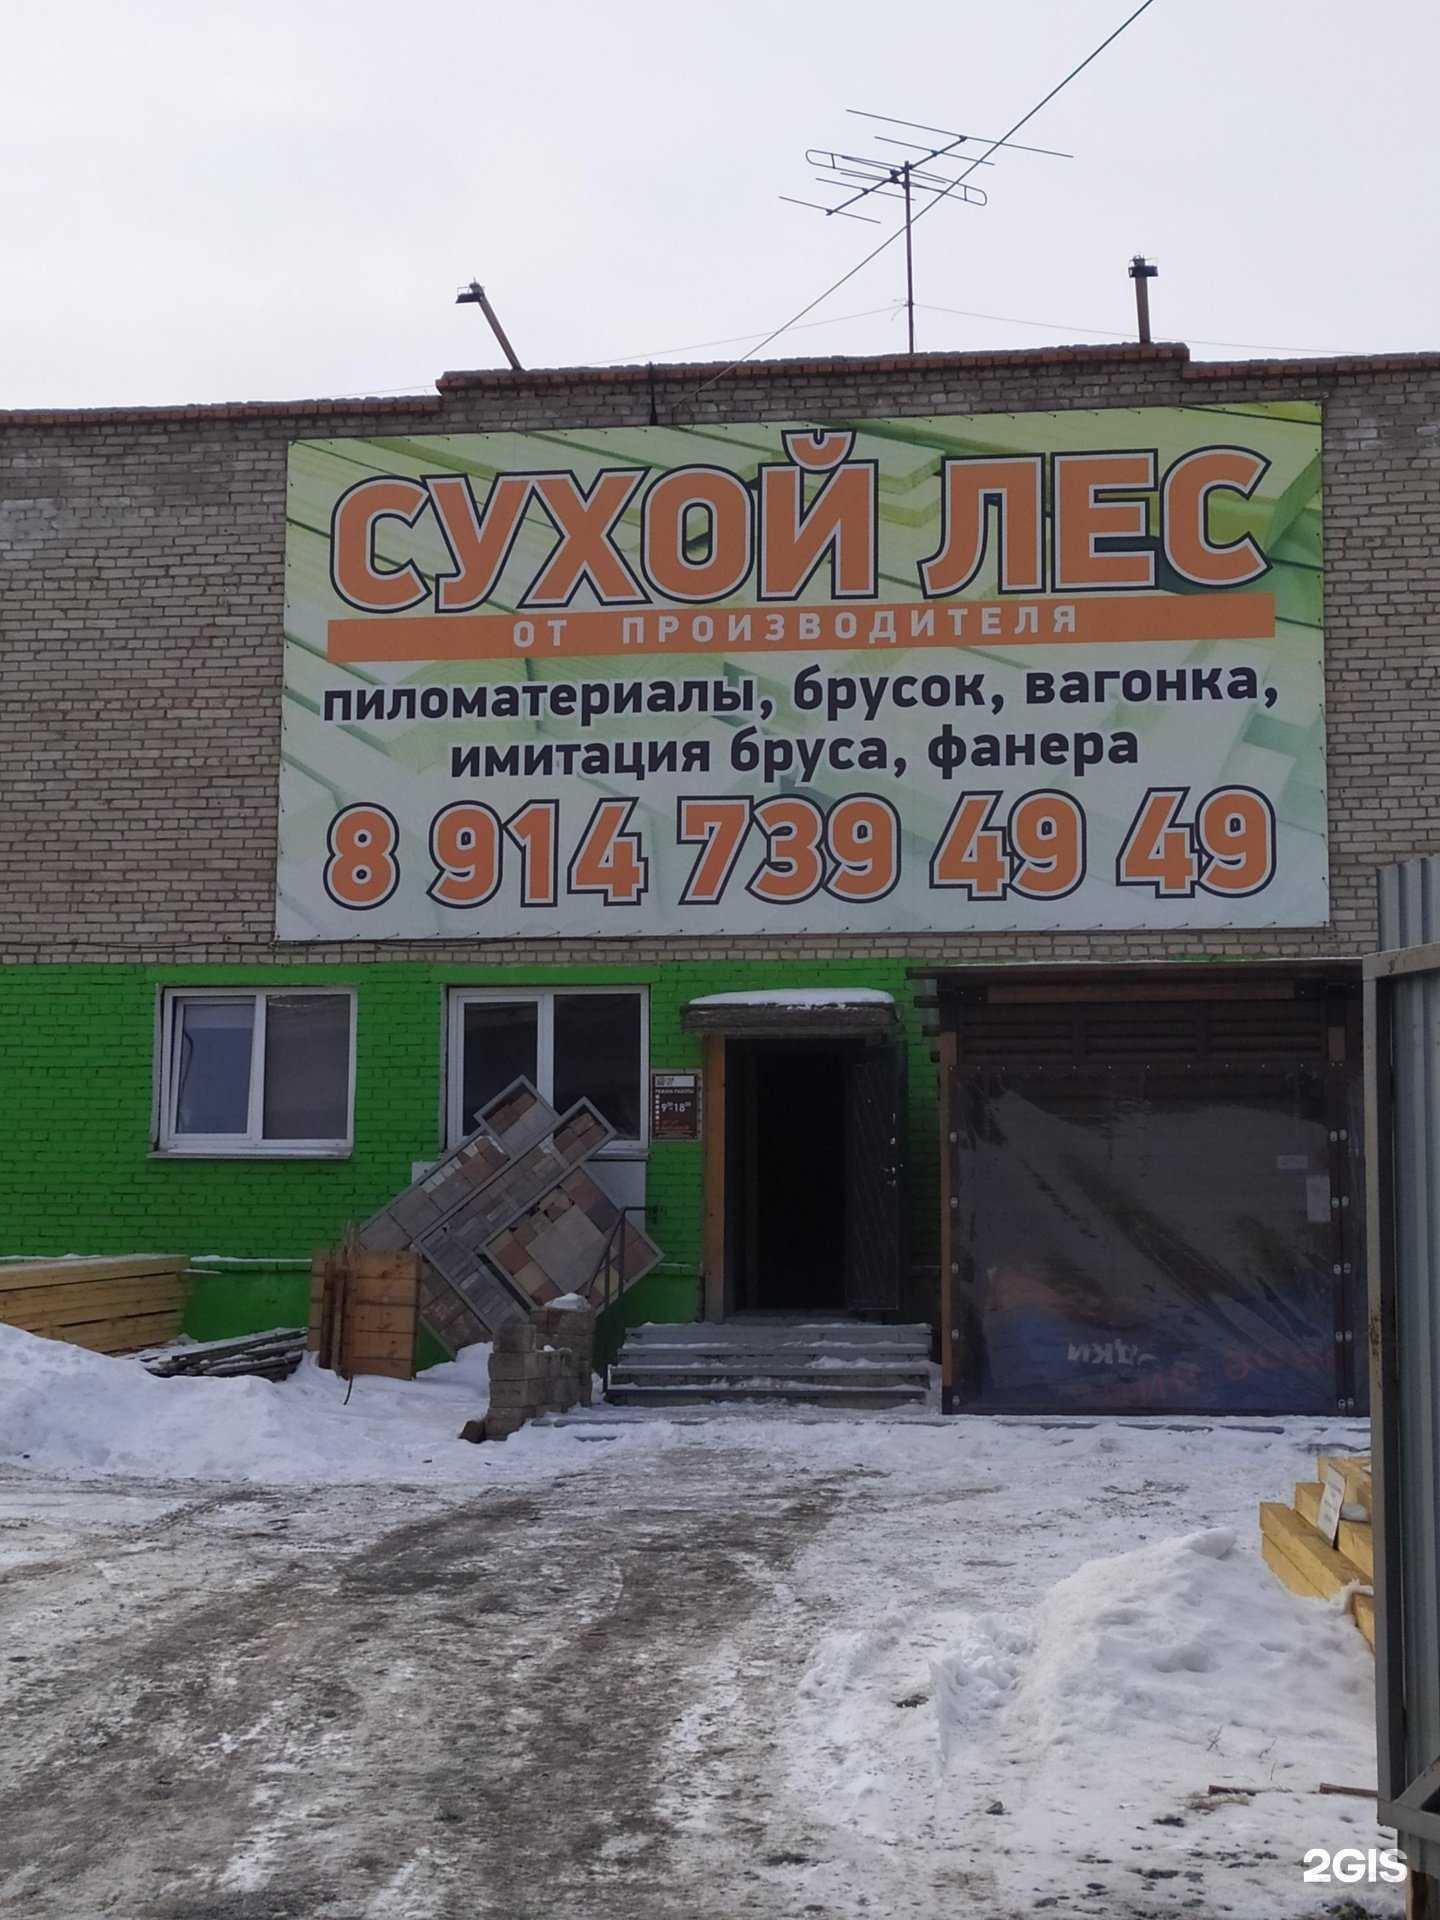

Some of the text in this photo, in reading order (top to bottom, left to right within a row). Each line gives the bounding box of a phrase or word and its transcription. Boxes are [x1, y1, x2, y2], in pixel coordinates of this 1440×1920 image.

[329, 429, 1272, 614] СУХОЙ ЛЕС
[512, 604, 1077, 648] ОТ ПРОИЗВОДИТЕЛЯ
[324, 663, 1278, 726] пиломатериалы, брусок, вагонка,
[451, 724, 1138, 782] имитация бруса, фанера
[323, 785, 1276, 910] 8 914 739 49 49
